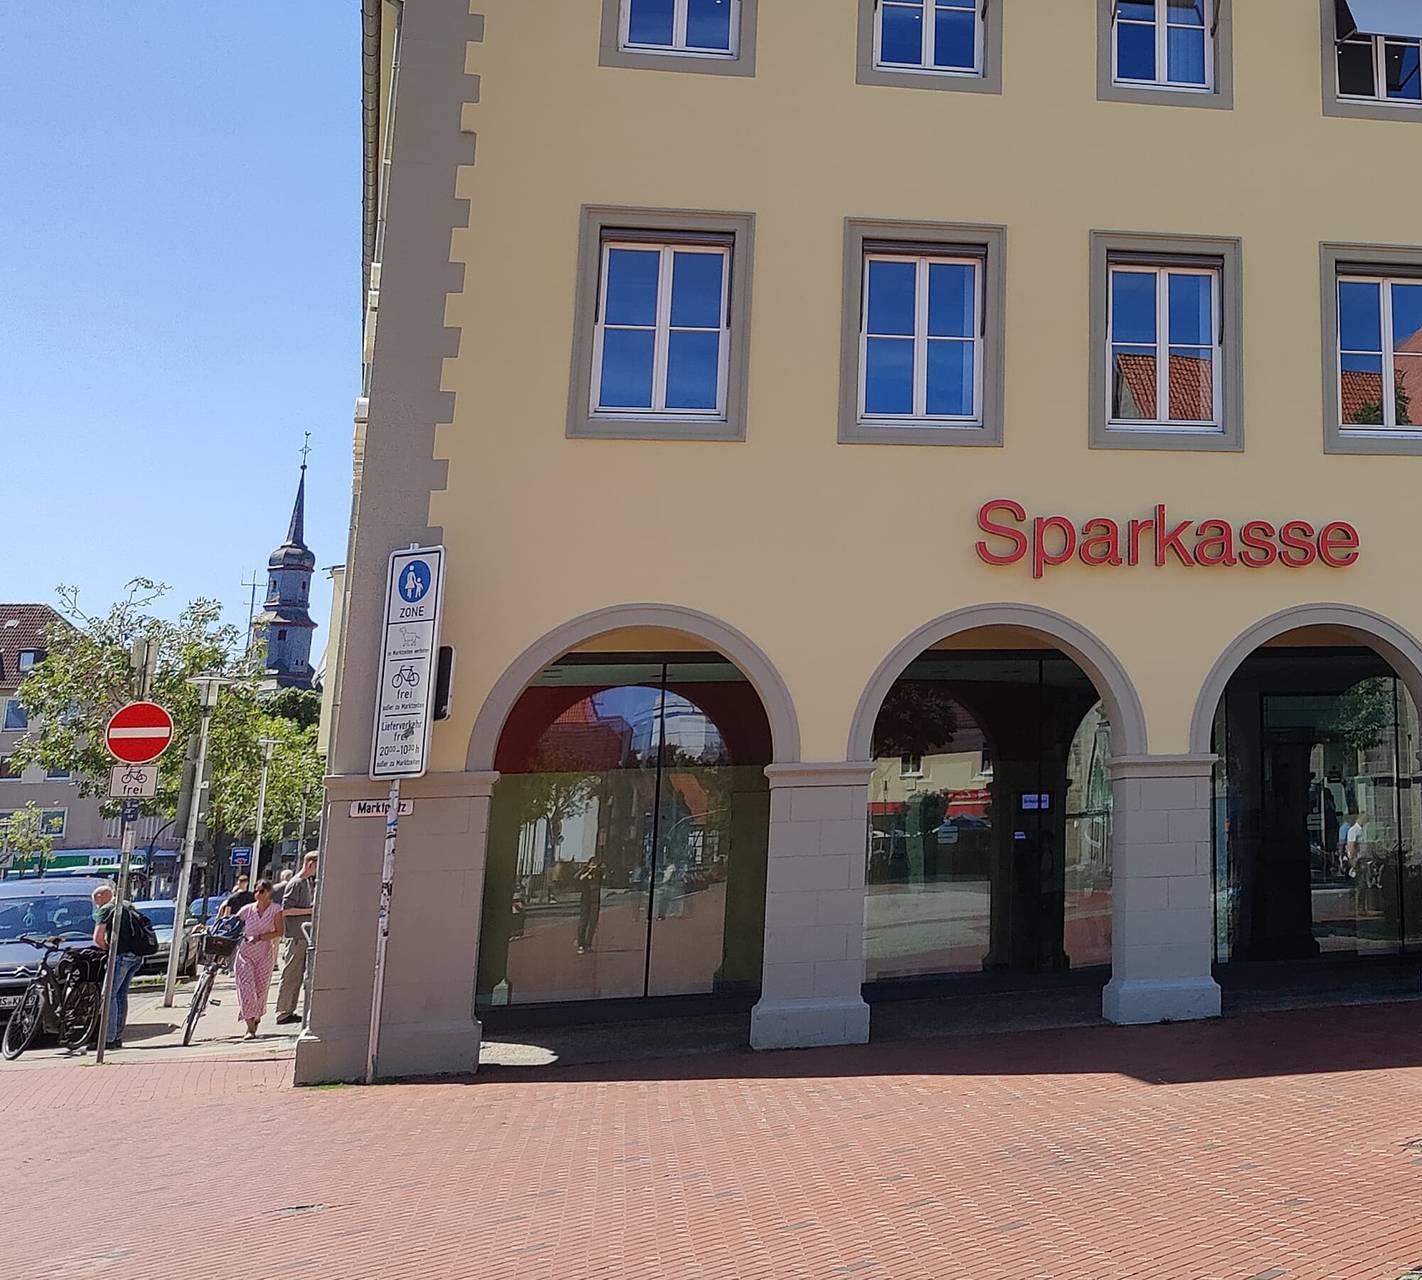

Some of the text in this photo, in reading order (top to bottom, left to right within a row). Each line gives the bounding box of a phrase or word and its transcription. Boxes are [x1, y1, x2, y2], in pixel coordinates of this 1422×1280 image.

[975, 498, 1361, 579] Sparkasse
[400, 605, 424, 618] ZONE
[397, 688, 413, 699] frei
[123, 785, 143, 794] frei
